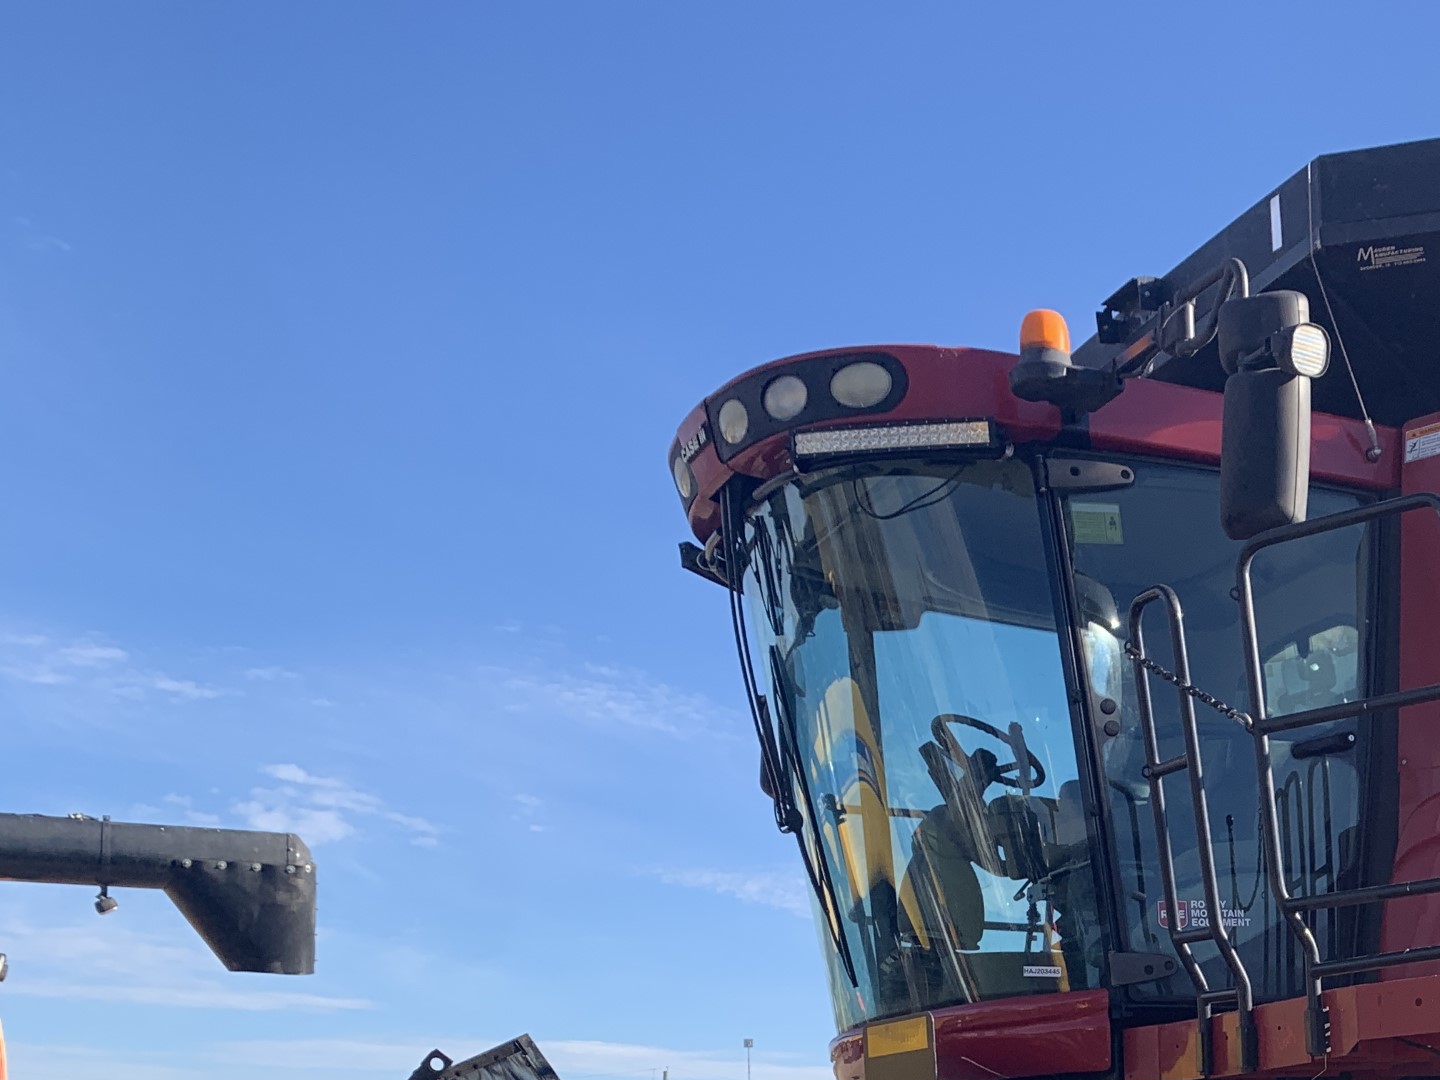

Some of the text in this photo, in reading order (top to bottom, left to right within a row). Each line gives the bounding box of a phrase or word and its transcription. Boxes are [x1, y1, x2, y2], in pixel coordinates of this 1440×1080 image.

[681, 435, 699, 463] CASE
[1191, 901, 1226, 909] ROY
[1161, 910, 1185, 919] RE
[1191, 909, 1245, 918] MOTAIN
